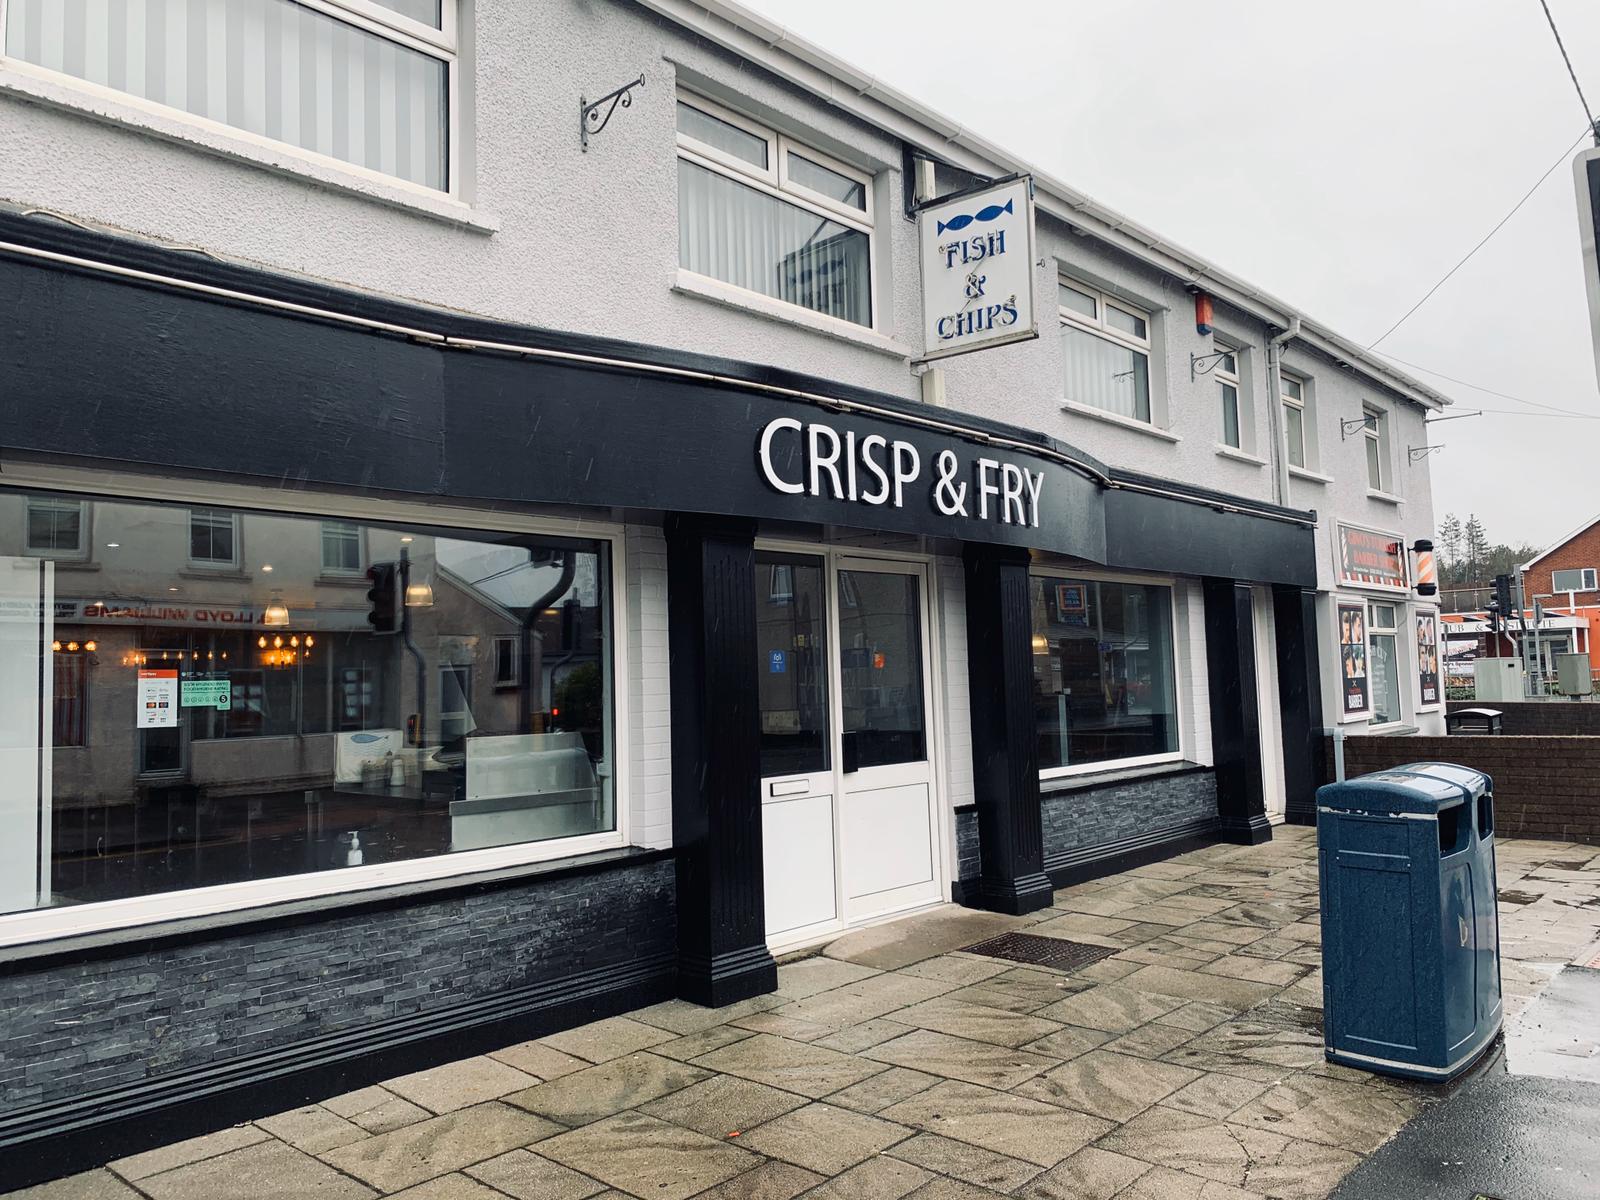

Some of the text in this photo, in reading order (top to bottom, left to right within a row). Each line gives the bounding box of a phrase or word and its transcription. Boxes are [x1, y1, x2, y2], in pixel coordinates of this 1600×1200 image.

[940, 229, 1007, 269] FISH
[965, 273, 987, 299] &
[938, 297, 1018, 340] CHIPS
[760, 417, 1045, 528] CRISP & FRY
